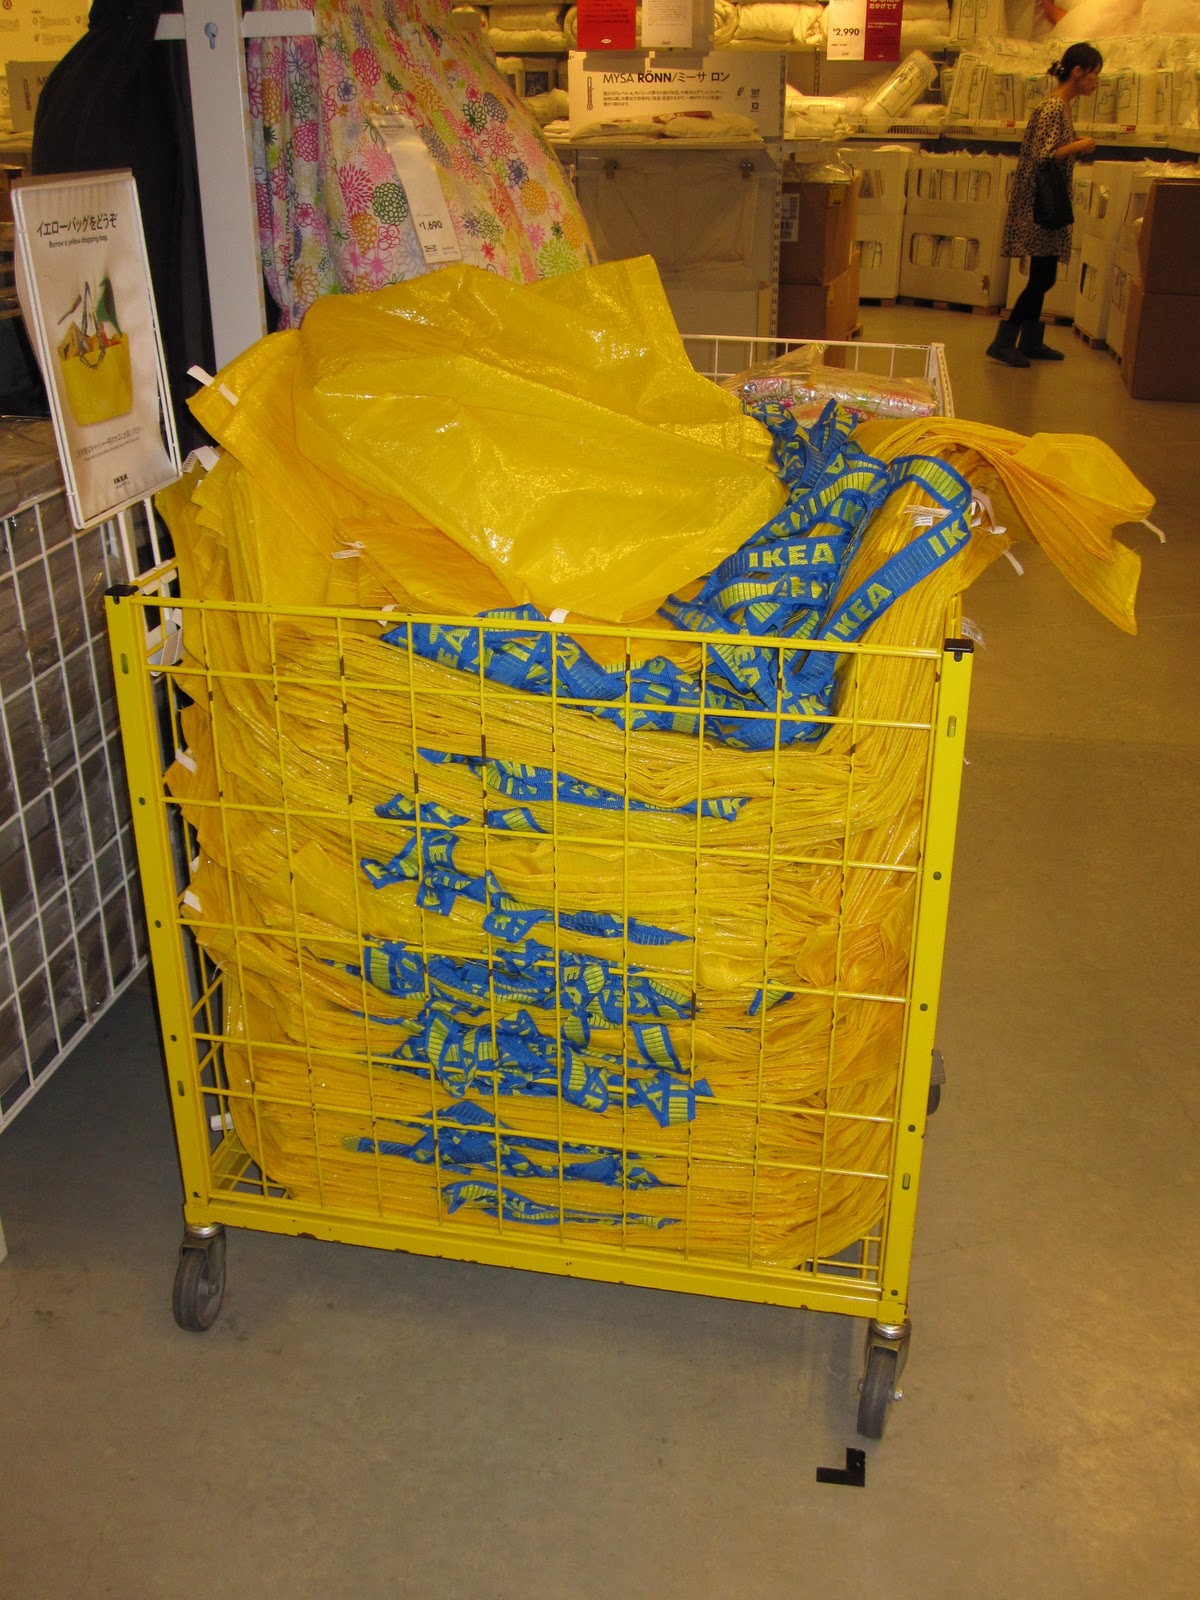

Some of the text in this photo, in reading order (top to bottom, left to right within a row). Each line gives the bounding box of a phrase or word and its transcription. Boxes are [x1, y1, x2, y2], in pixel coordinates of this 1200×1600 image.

[833, 28, 860, 36] ¥2,990
[603, 73, 635, 84] MYSA
[711, 72, 730, 82] ロン
[37, 213, 118, 238] イエローバッグをどうぞ
[49, 240, 64, 249] Borrow
[68, 238, 81, 247] yellow
[82, 235, 99, 245] shopping
[113, 474, 128, 484] IKEA
[927, 512, 971, 558] IK
[749, 542, 835, 568] IKEA
